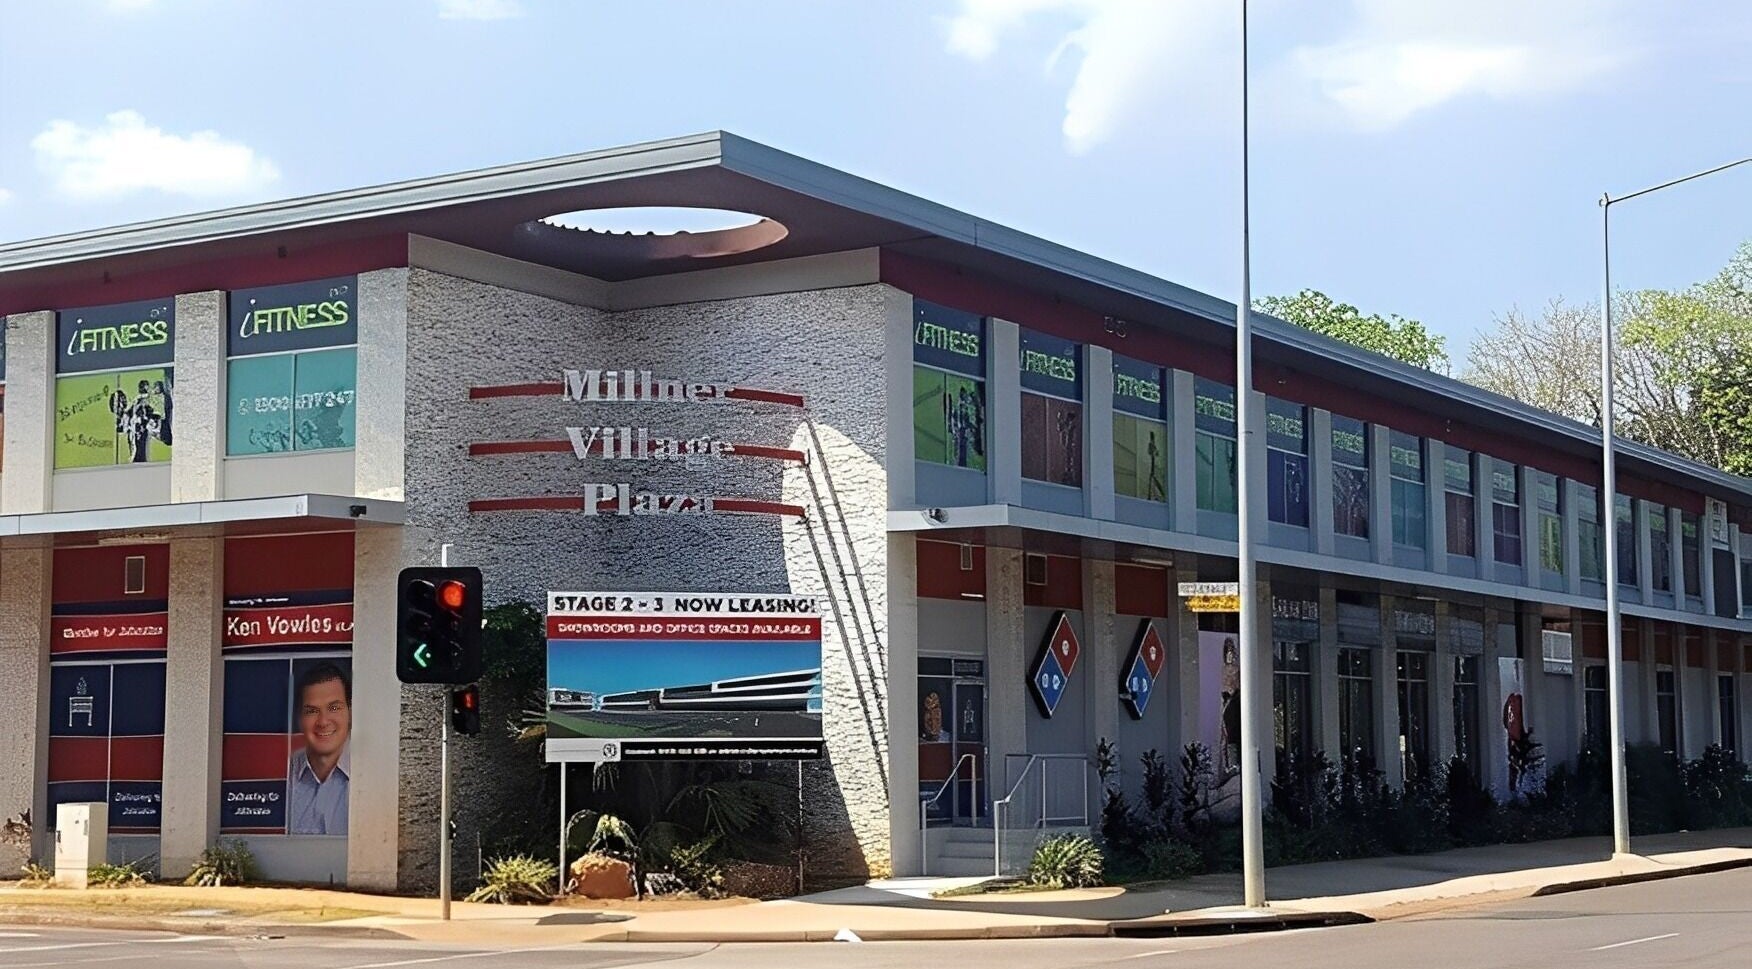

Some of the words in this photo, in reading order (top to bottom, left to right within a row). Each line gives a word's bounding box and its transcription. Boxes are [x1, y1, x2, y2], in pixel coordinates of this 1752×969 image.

[562, 368, 735, 402] Millner
[566, 426, 736, 471] Village
[583, 483, 714, 516] Plaza
[554, 596, 616, 612] STAGE
[621, 597, 634, 612] 2
[674, 598, 721, 613] NOW
[728, 598, 817, 614] LEASING!
[227, 616, 261, 637] Ken
[267, 614, 332, 635] Vowles
